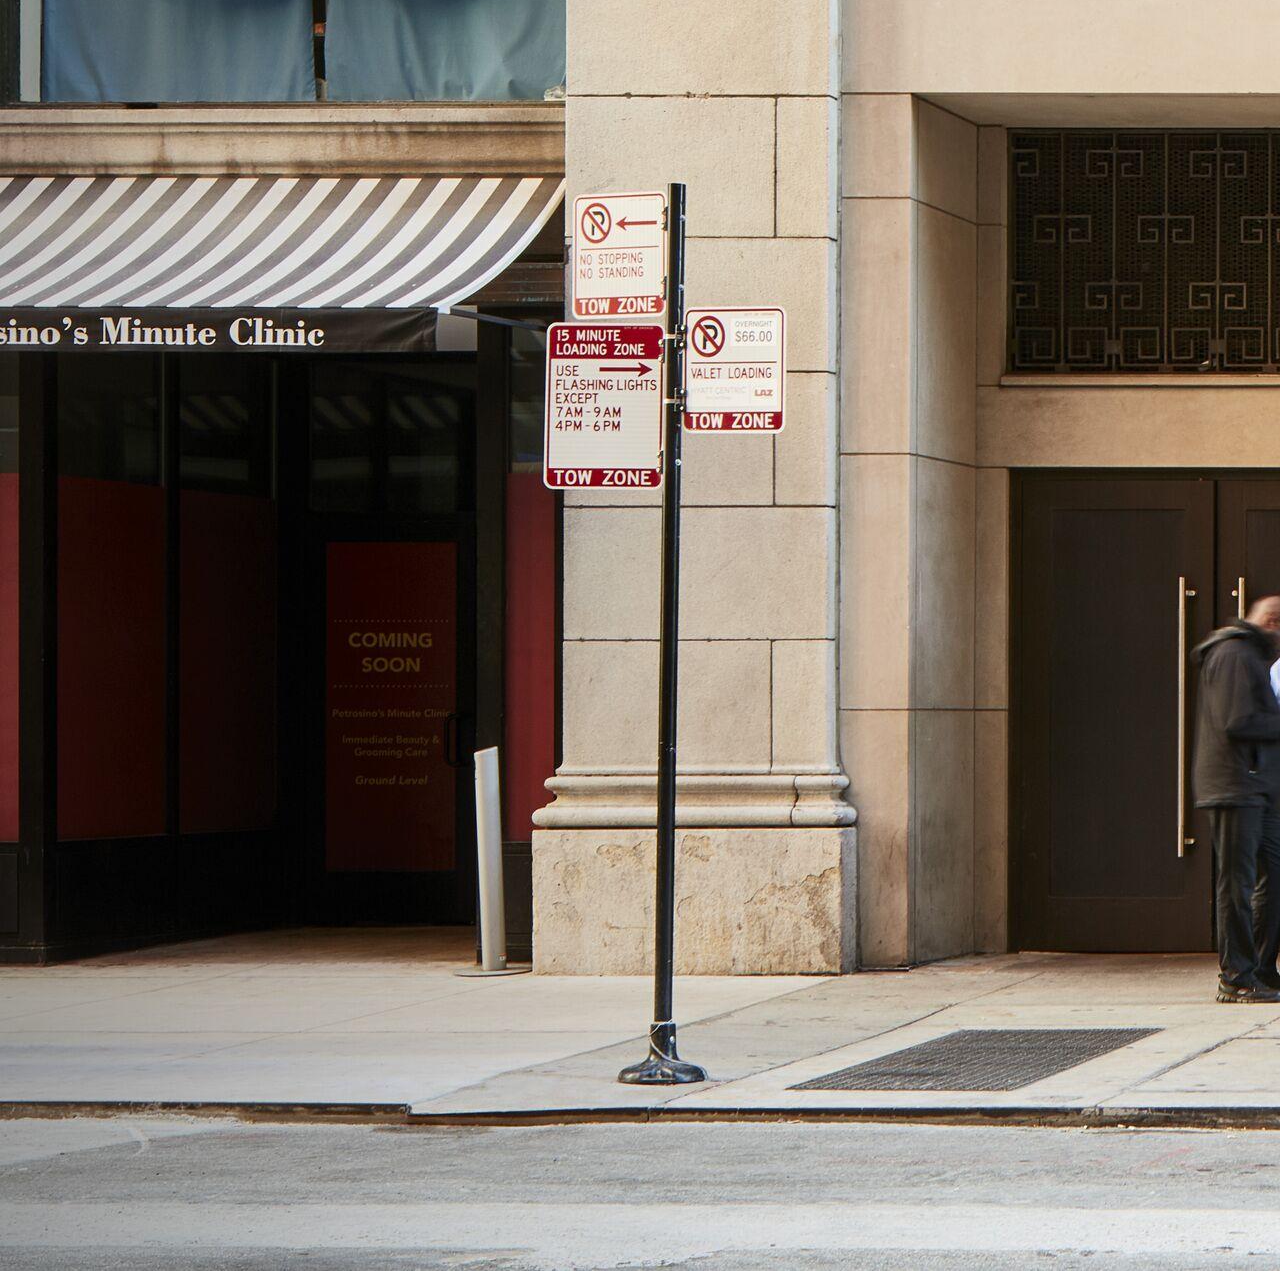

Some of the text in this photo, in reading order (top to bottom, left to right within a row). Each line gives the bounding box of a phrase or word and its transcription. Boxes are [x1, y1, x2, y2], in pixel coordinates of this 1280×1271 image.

[580, 252, 644, 265] NO STOPPING
[580, 266, 644, 279] NO STANDING
[579, 296, 657, 314] TOW ZONE
[99, 317, 217, 346] Minute
[229, 317, 325, 346] Clinic
[556, 329, 621, 341] 15 MINUTE
[735, 330, 773, 342] $66.00
[556, 343, 645, 355] LOADING ZONE
[556, 365, 579, 376] USE
[691, 367, 772, 379] VALET LOADING
[555, 379, 657, 391] FLASHING LIGHTS
[555, 393, 599, 404] EXCEPT
[754, 389, 774, 397] LAZ
[689, 413, 775, 428] TOW ZONE
[554, 470, 652, 485] TOW ZONE
[348, 632, 433, 648] COMING
[361, 657, 421, 673] SOON
[332, 709, 450, 718] Petrosino's Minute Clinic
[342, 735, 440, 746] Immediate Beauty &
[354, 748, 428, 759] Grooming Care
[355, 775, 428, 786] Ground Level
